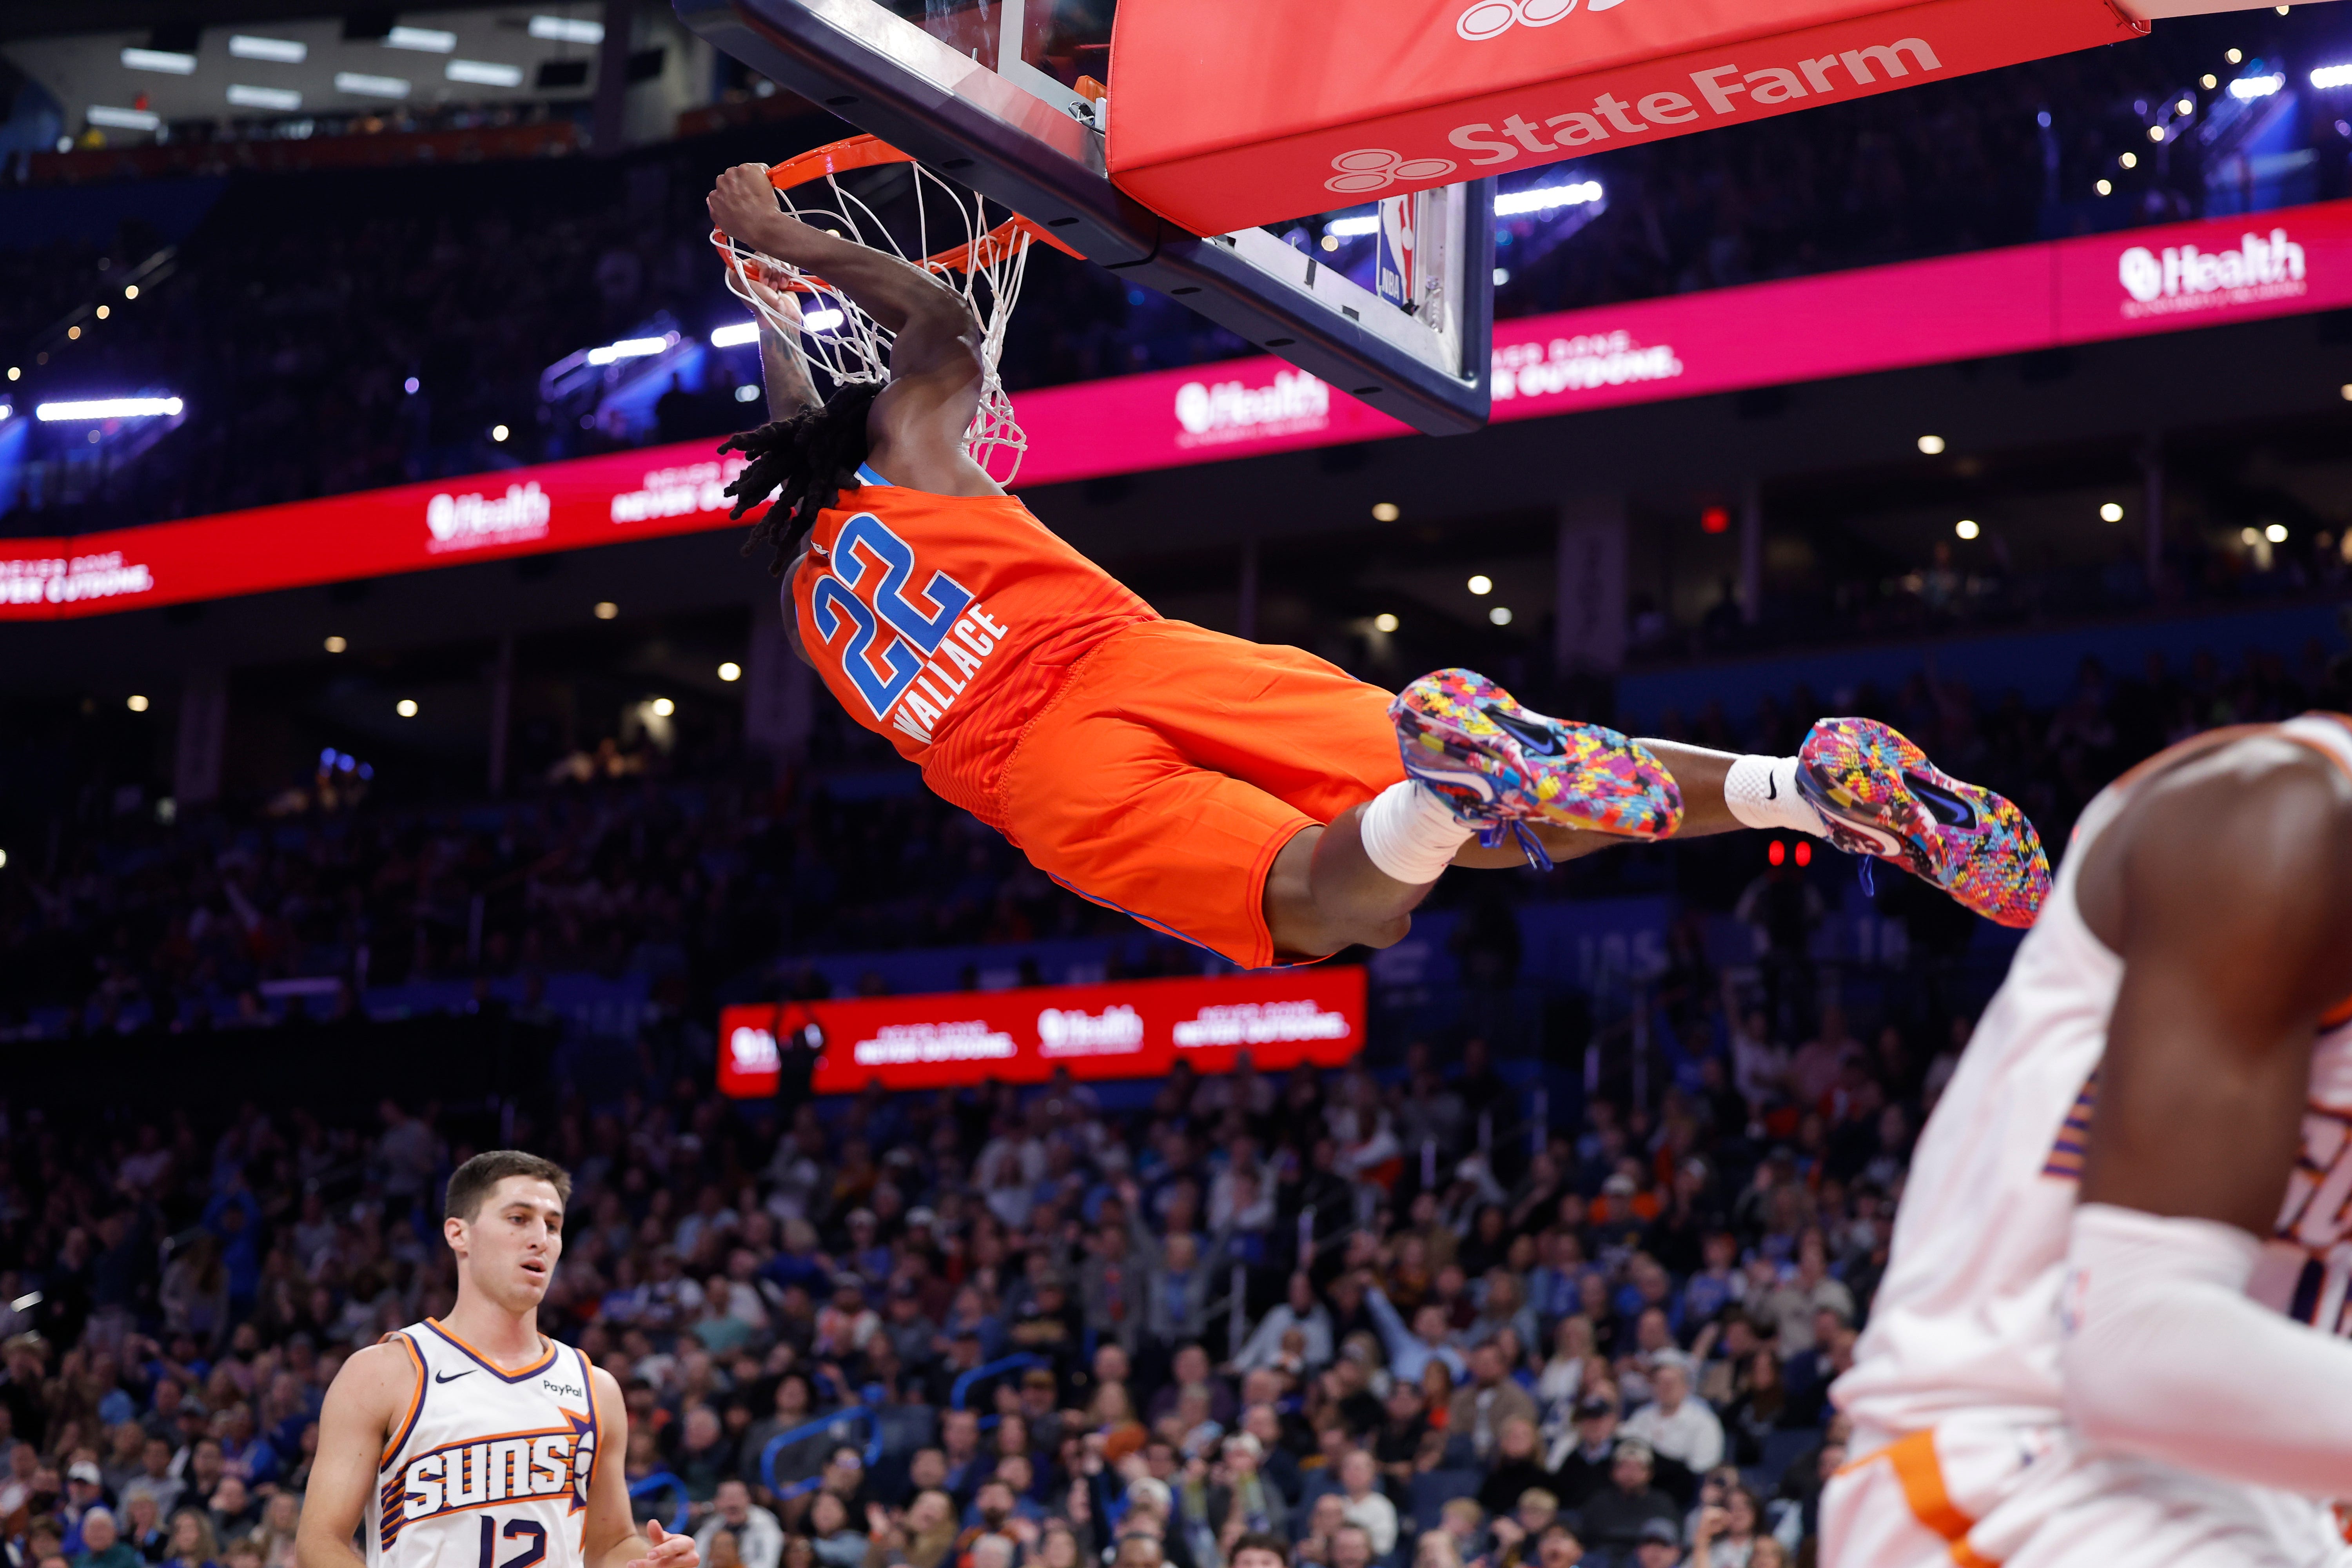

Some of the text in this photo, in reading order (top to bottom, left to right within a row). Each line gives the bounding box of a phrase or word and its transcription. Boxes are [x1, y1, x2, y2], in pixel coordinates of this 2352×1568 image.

[1382, 267, 1400, 300] NBA
[2161, 227, 2306, 297] Health
[812, 512, 975, 722] 22
[893, 603, 1009, 744] WALLACE
[543, 1379, 582, 1397] PayPal
[479, 1514, 548, 1568] 12
